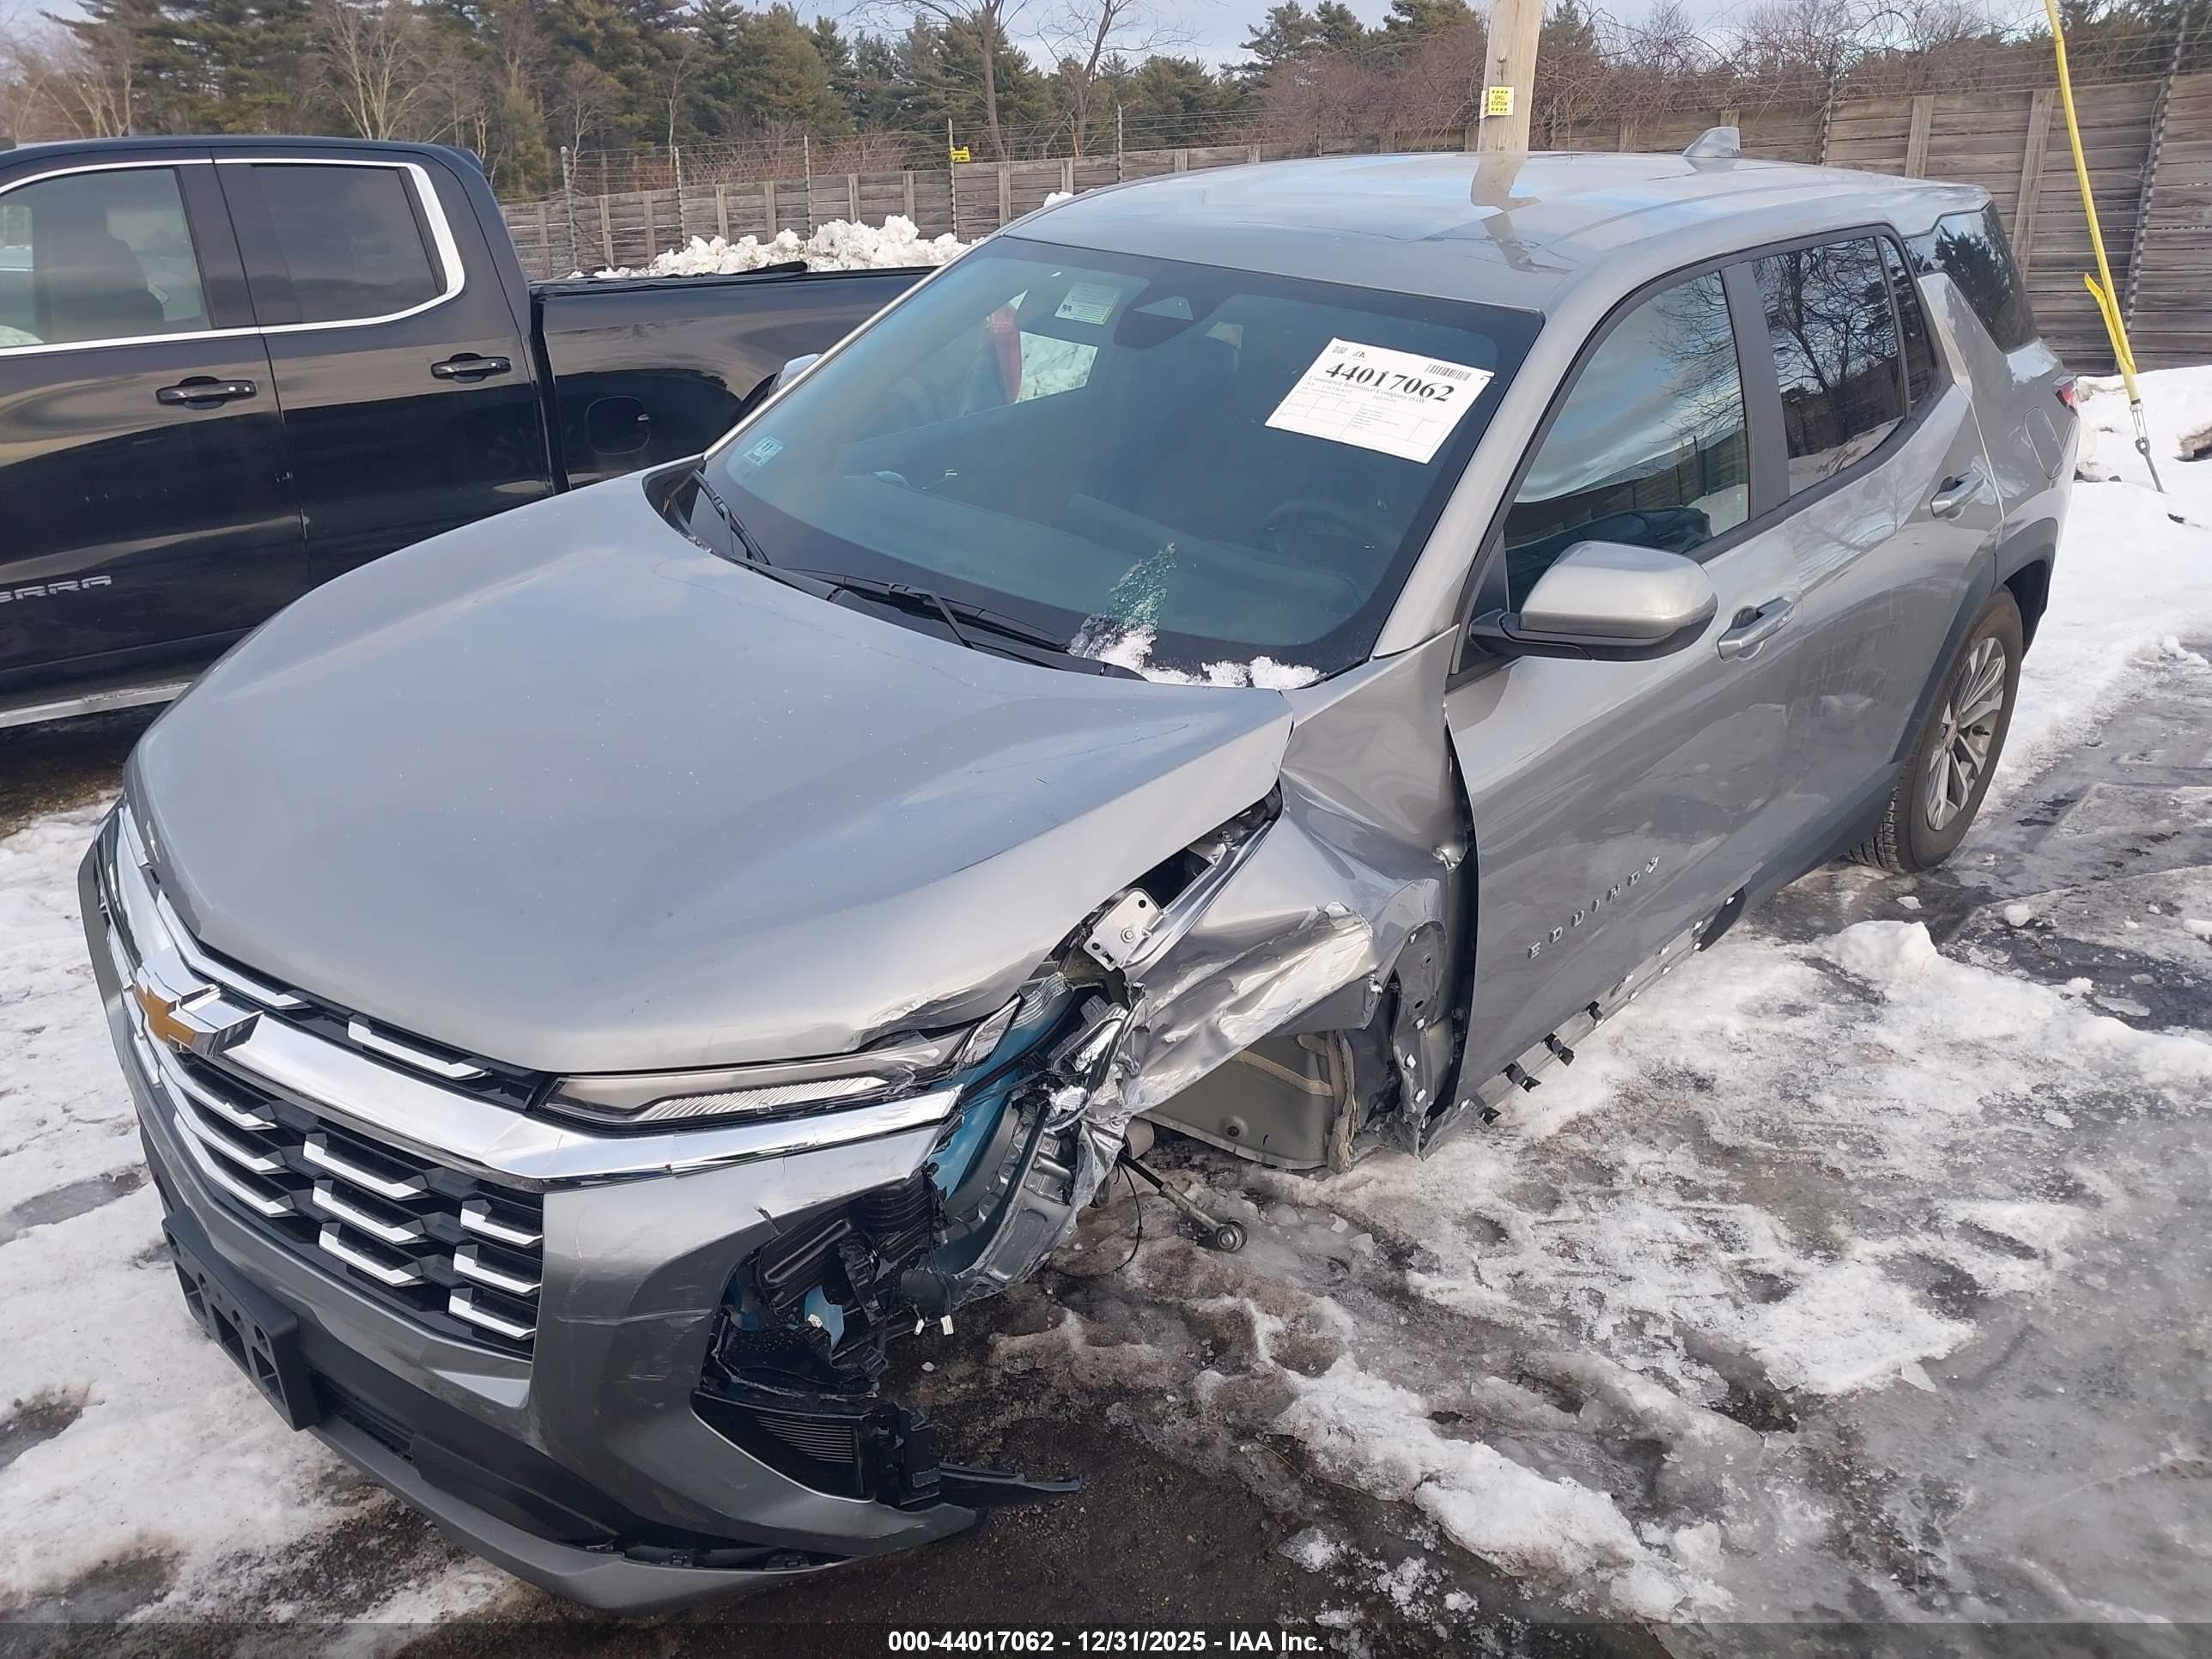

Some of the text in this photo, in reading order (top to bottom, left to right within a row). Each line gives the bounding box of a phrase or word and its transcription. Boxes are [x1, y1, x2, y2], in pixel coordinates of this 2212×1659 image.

[1325, 362, 1455, 403] 44017062
[1376, 388, 1408, 400] Company
[1528, 855, 1660, 960] EQUINOX
